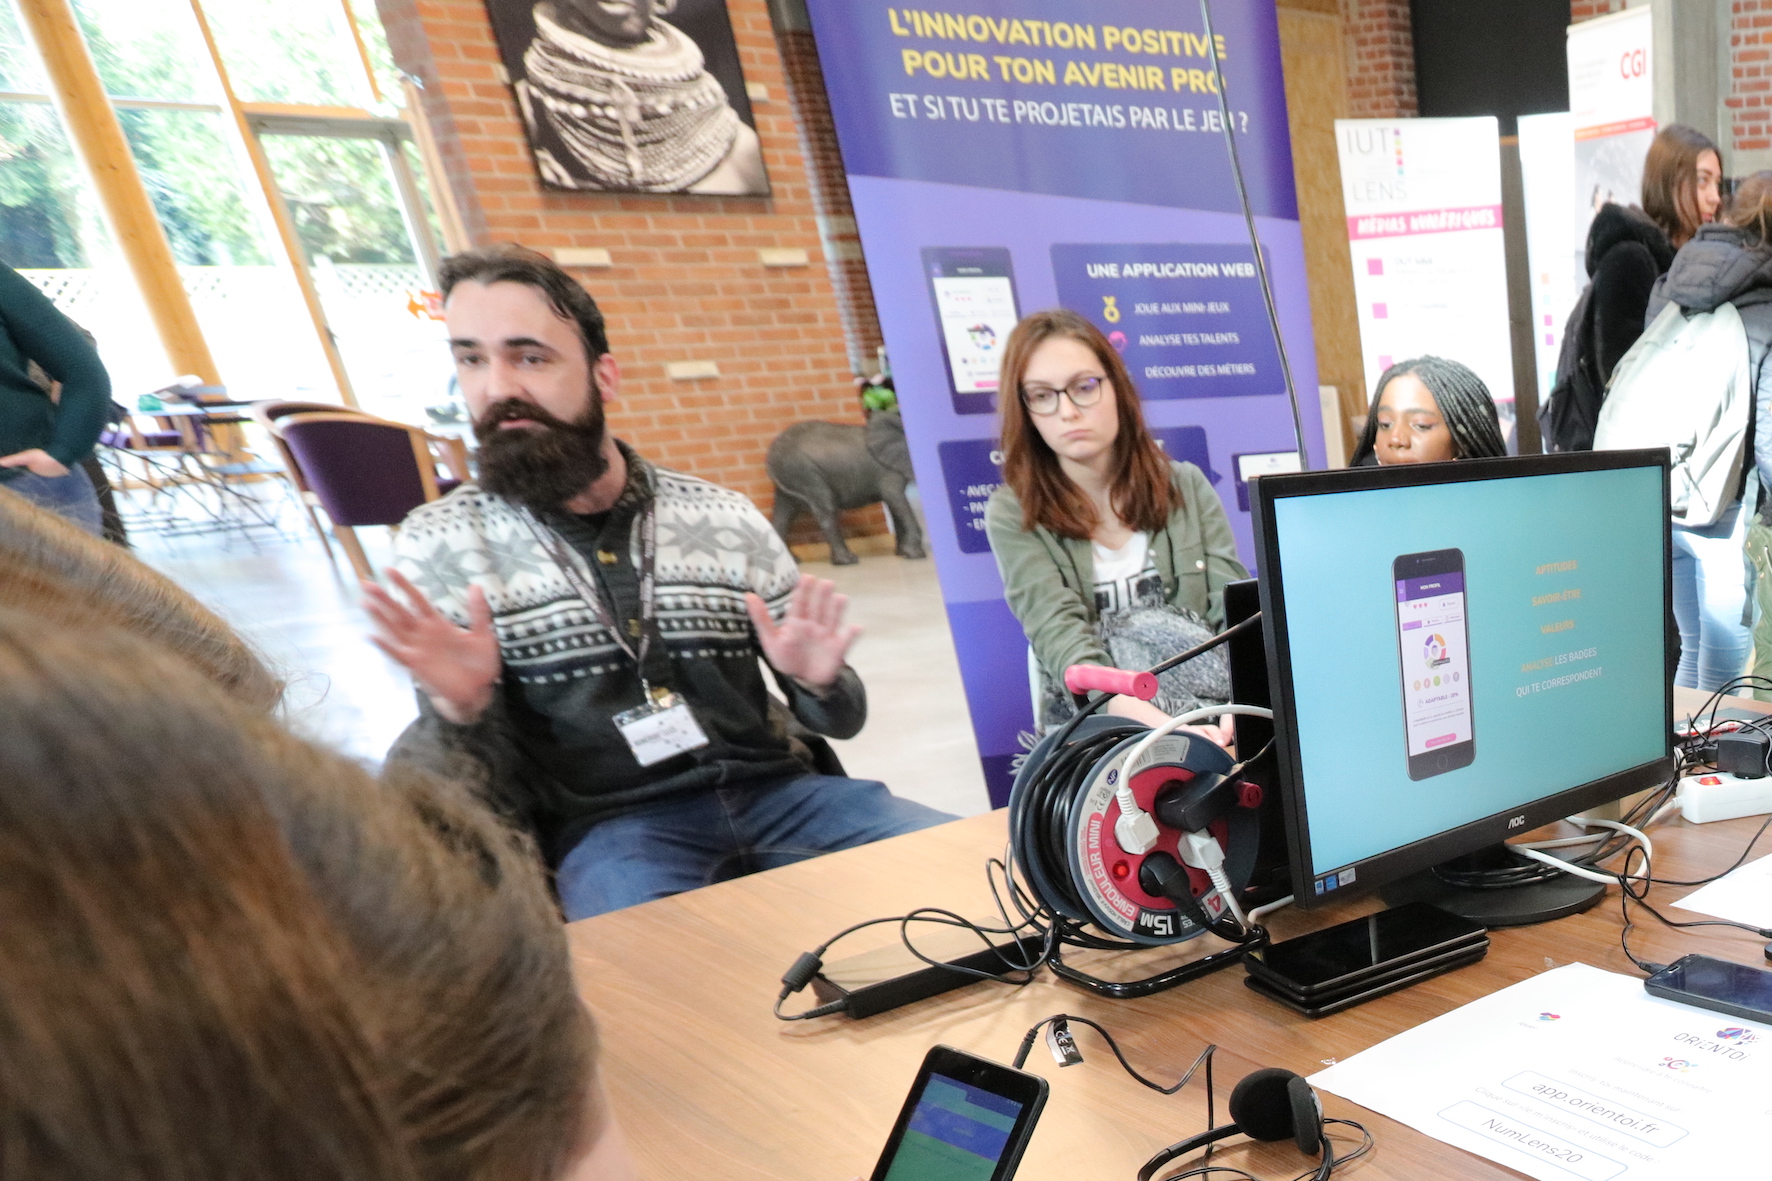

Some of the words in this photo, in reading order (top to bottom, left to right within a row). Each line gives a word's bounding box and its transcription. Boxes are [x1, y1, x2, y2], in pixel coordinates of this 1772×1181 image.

[888, 8, 1096, 50] L'INNOVATION
[1102, 25, 1227, 60] POSITIVE
[902, 48, 990, 81] POUR
[994, 55, 1057, 85] TON
[1063, 61, 1166, 92] AVENIR
[1171, 67, 1227, 95] PRO
[1620, 47, 1647, 80] CGI
[889, 93, 918, 119] ET
[922, 95, 946, 120] SI
[946, 96, 980, 122] TU
[981, 98, 1011, 123] TE
[1013, 100, 1126, 129] PROJETAIS
[1129, 105, 1169, 131] PAR
[1172, 108, 1196, 132] LE
[1199, 110, 1235, 133] JEU
[1238, 111, 1249, 133] ?
[1346, 127, 1390, 155] IUT
[1352, 181, 1408, 203] LENS
[1358, 214, 1407, 237] MÉDIAS
[1410, 208, 1496, 232] NUMÉRIQUES
[1086, 263, 1120, 278] UNE
[1122, 263, 1218, 278] APPLICATION
[1220, 262, 1256, 277] WEB
[1134, 302, 1160, 316] JOUE
[1160, 302, 1182, 315] AUX
[1182, 301, 1230, 314] MINI-JEUX
[1139, 333, 1181, 347] ANALYSE
[1181, 333, 1199, 345] TES
[1199, 332, 1240, 345] TALENTS
[1145, 364, 1196, 379] DÉCOUVRE
[1197, 363, 1216, 377] DES
[1217, 362, 1256, 376] MÉTIERS
[1535, 559, 1578, 575] APTITUDES
[1531, 588, 1582, 607] SAVOIR-ÊTRE
[1540, 619, 1575, 634] VALEURS
[1521, 656, 1554, 673] ANALYSE
[1554, 652, 1568, 666] LES
[1568, 647, 1597, 663] BADGES
[1516, 685, 1530, 698] QUI
[1531, 682, 1541, 694] TE
[1541, 666, 1602, 691] CORRESPONDENT
[1089, 820, 1101, 849] MINI
[1508, 815, 1525, 829] AOC
[1090, 851, 1136, 917] ENROULEUR
[1207, 895, 1221, 912] 4
[1140, 912, 1174, 936] 15M
[1614, 1055, 1657, 1075] Apprendre
[1532, 1083, 1660, 1135] app.orientoi.fr
[1612, 1085, 1664, 1107] maintenant
[1664, 1104, 1681, 1114] sur
[1474, 1086, 1502, 1104] Clique
[1502, 1099, 1520, 1109] sur
[1590, 1131, 1618, 1148] utilise
[1629, 1149, 1654, 1163] code
[1482, 1118, 1584, 1164] NumLens20
